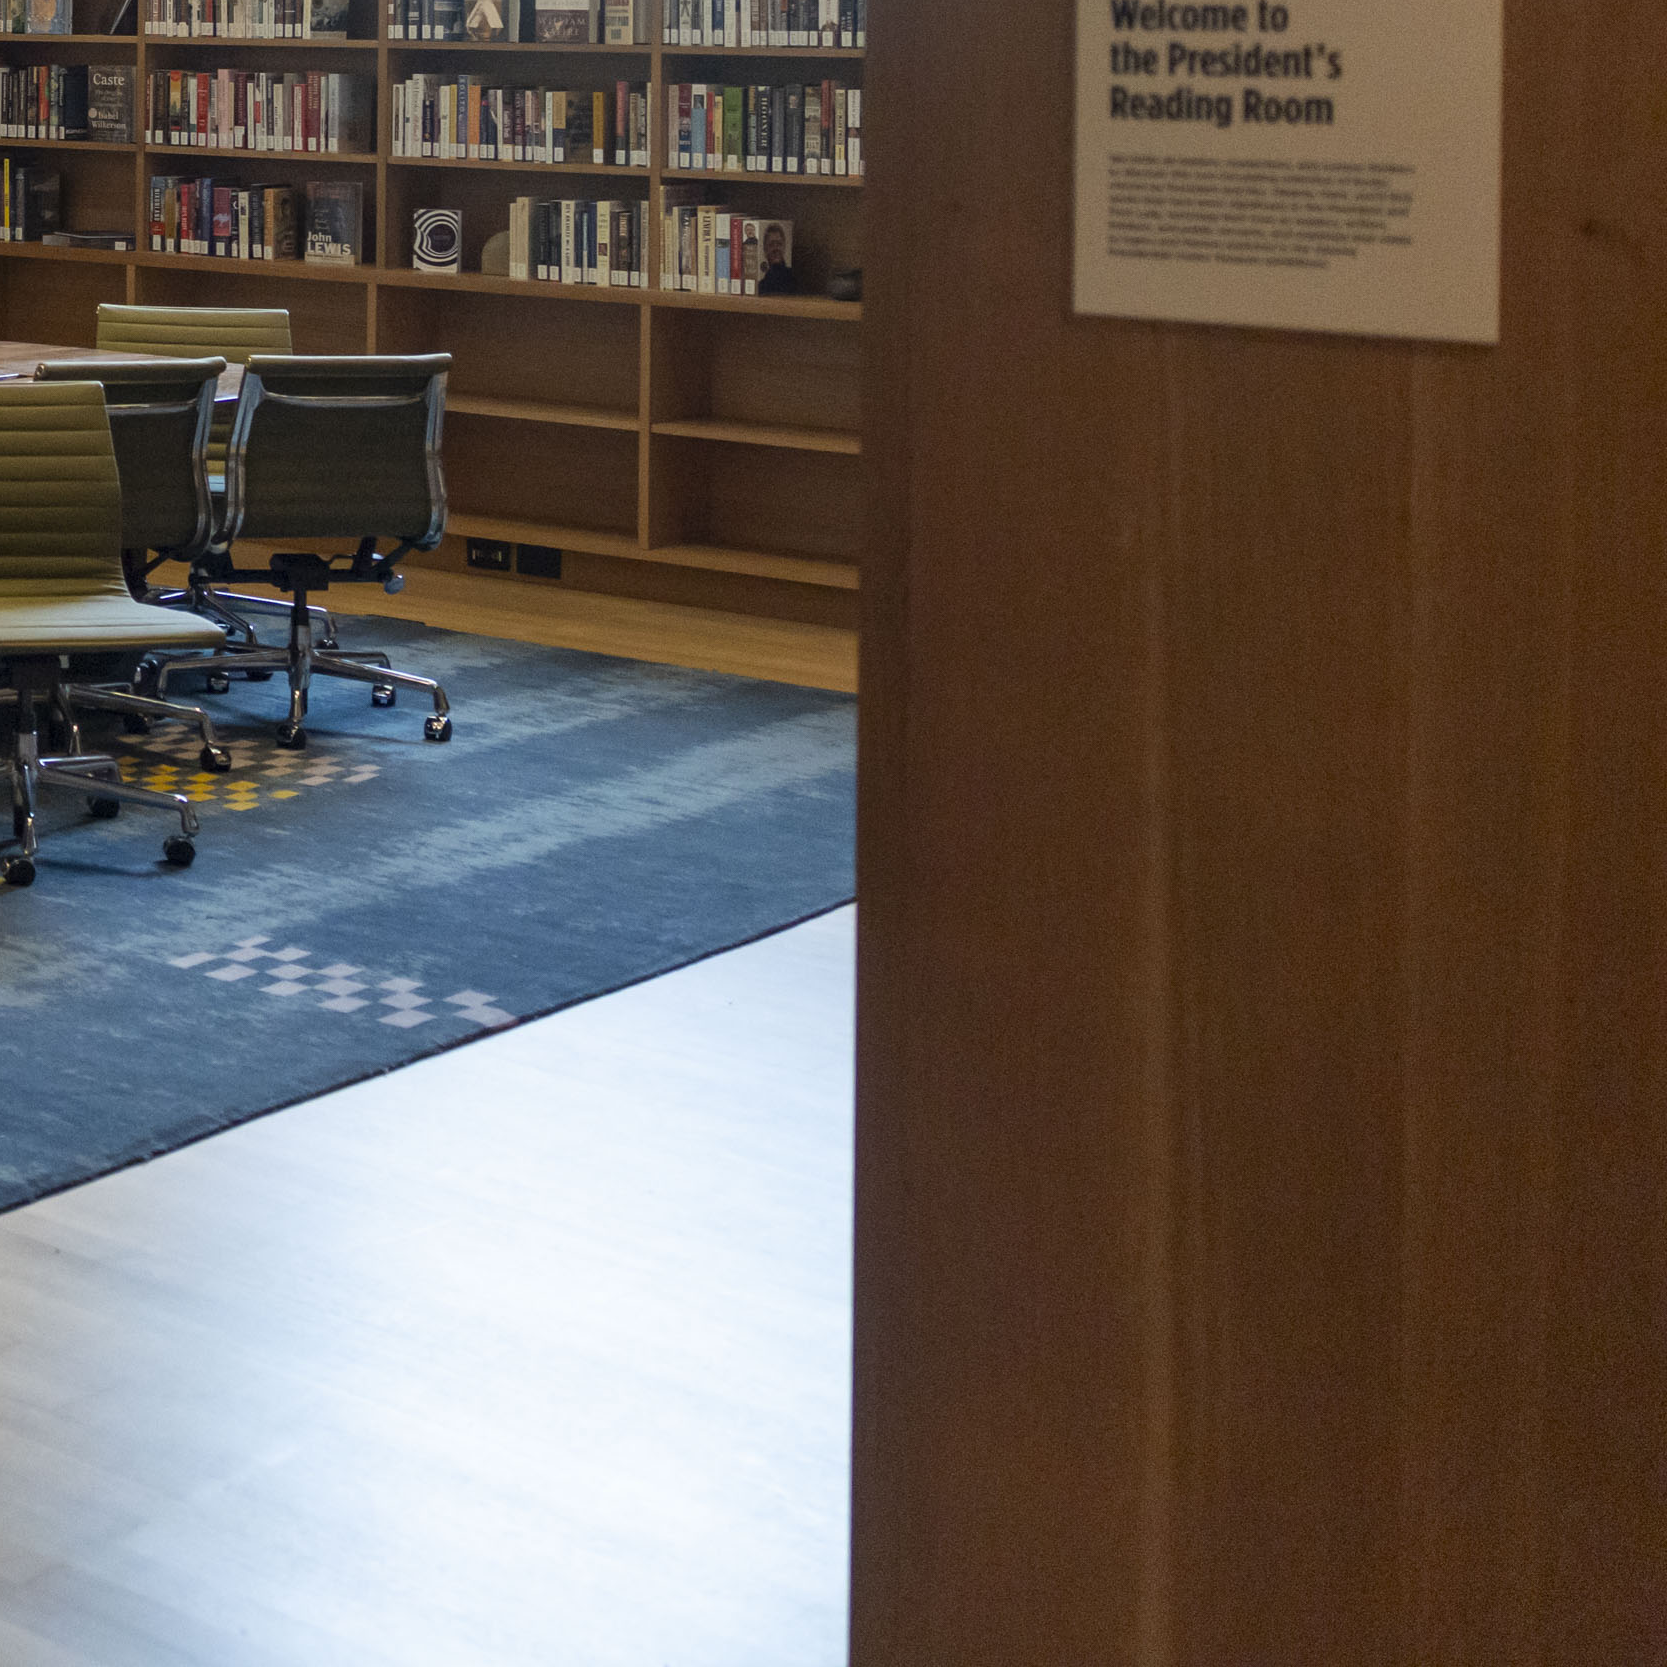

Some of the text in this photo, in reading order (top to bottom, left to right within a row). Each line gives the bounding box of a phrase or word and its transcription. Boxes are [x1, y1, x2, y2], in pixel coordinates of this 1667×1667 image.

[1109, 41, 1342, 81] the President's
[92, 73, 126, 87] Caste
[1109, 85, 1335, 129] Reading Room
[307, 231, 332, 242] John
[307, 242, 352, 255] LEWIS
